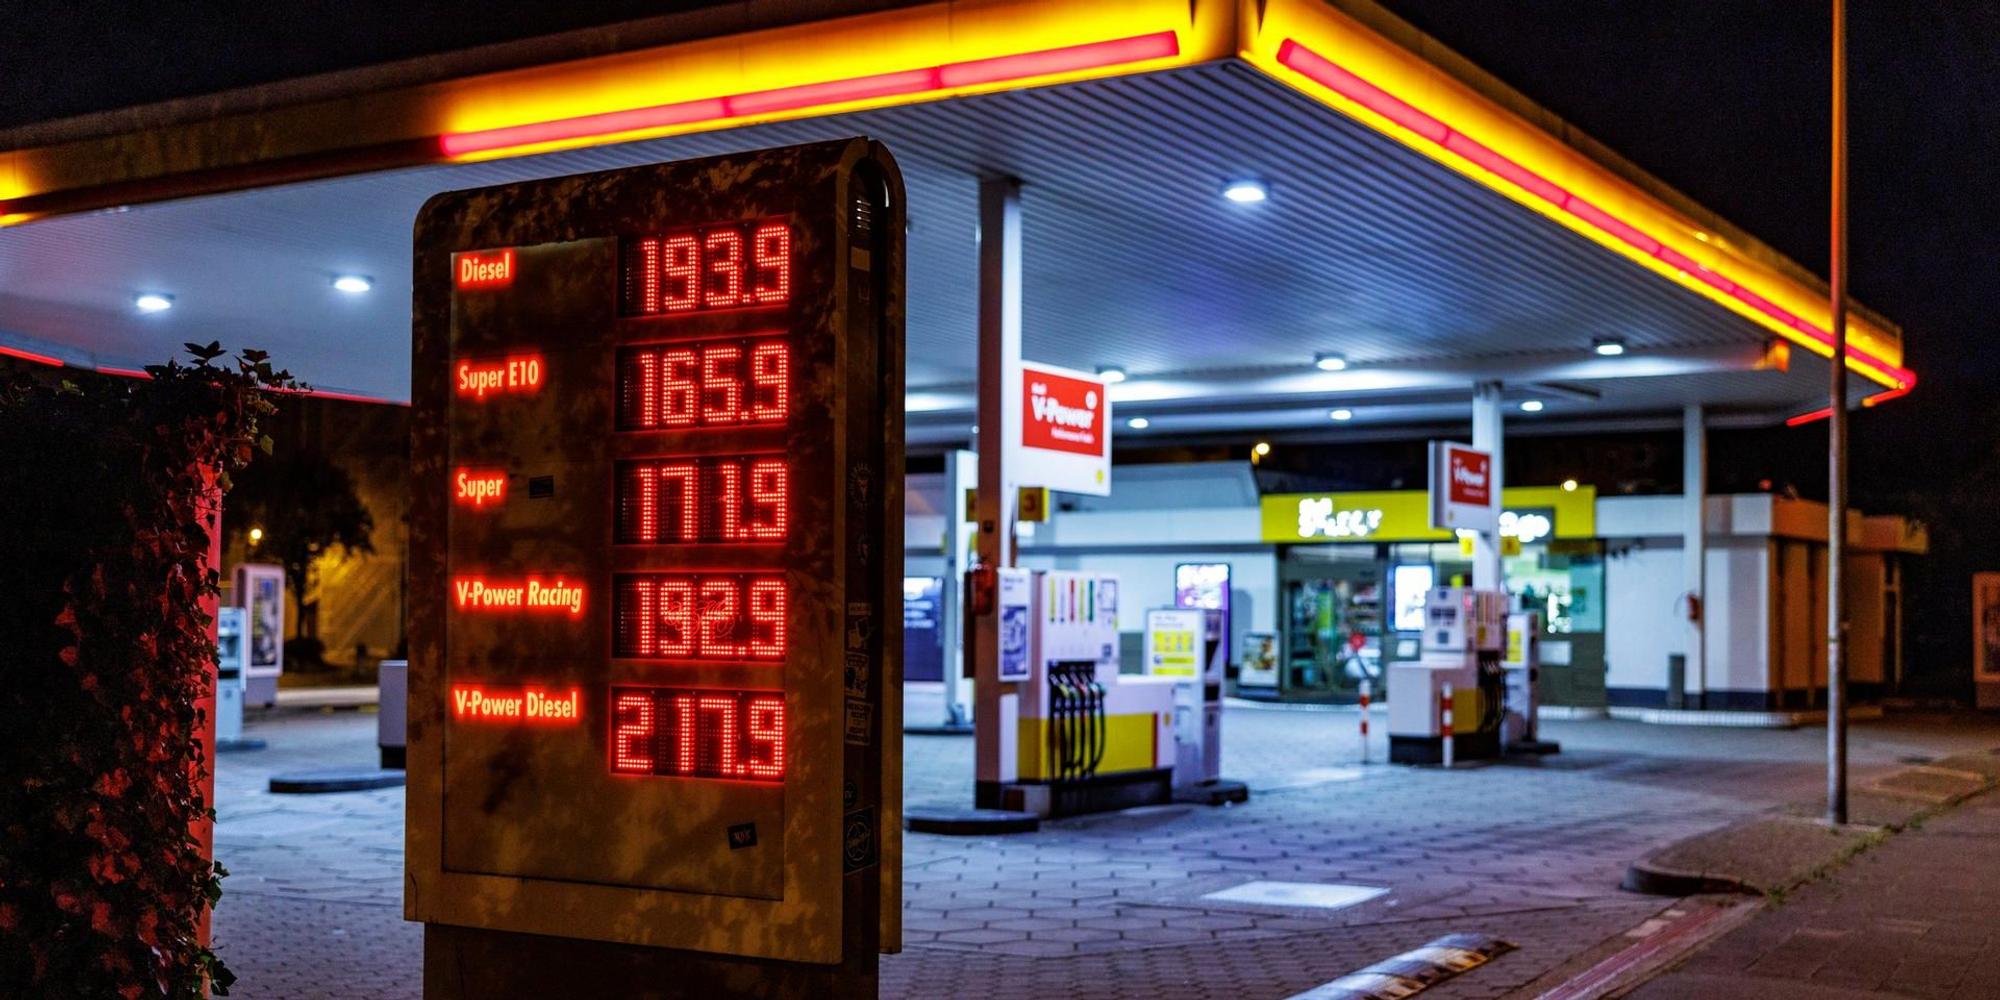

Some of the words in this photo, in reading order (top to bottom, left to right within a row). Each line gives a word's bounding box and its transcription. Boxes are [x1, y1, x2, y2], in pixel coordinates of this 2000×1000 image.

[461, 252, 510, 283] Diesel
[642, 225, 790, 313] 193.9
[459, 365, 505, 396] Super
[509, 359, 539, 387] E10
[640, 344, 788, 426] 165.9
[1031, 395, 1095, 429] V-Power
[457, 473, 504, 504] Super
[639, 462, 787, 539] 171.9
[456, 581, 524, 606] V-Power
[527, 580, 583, 614] Racing
[638, 580, 786, 656] 192.9
[454, 690, 523, 717] V-Power
[526, 690, 578, 718] Diesel
[616, 695, 785, 776] 217.9
